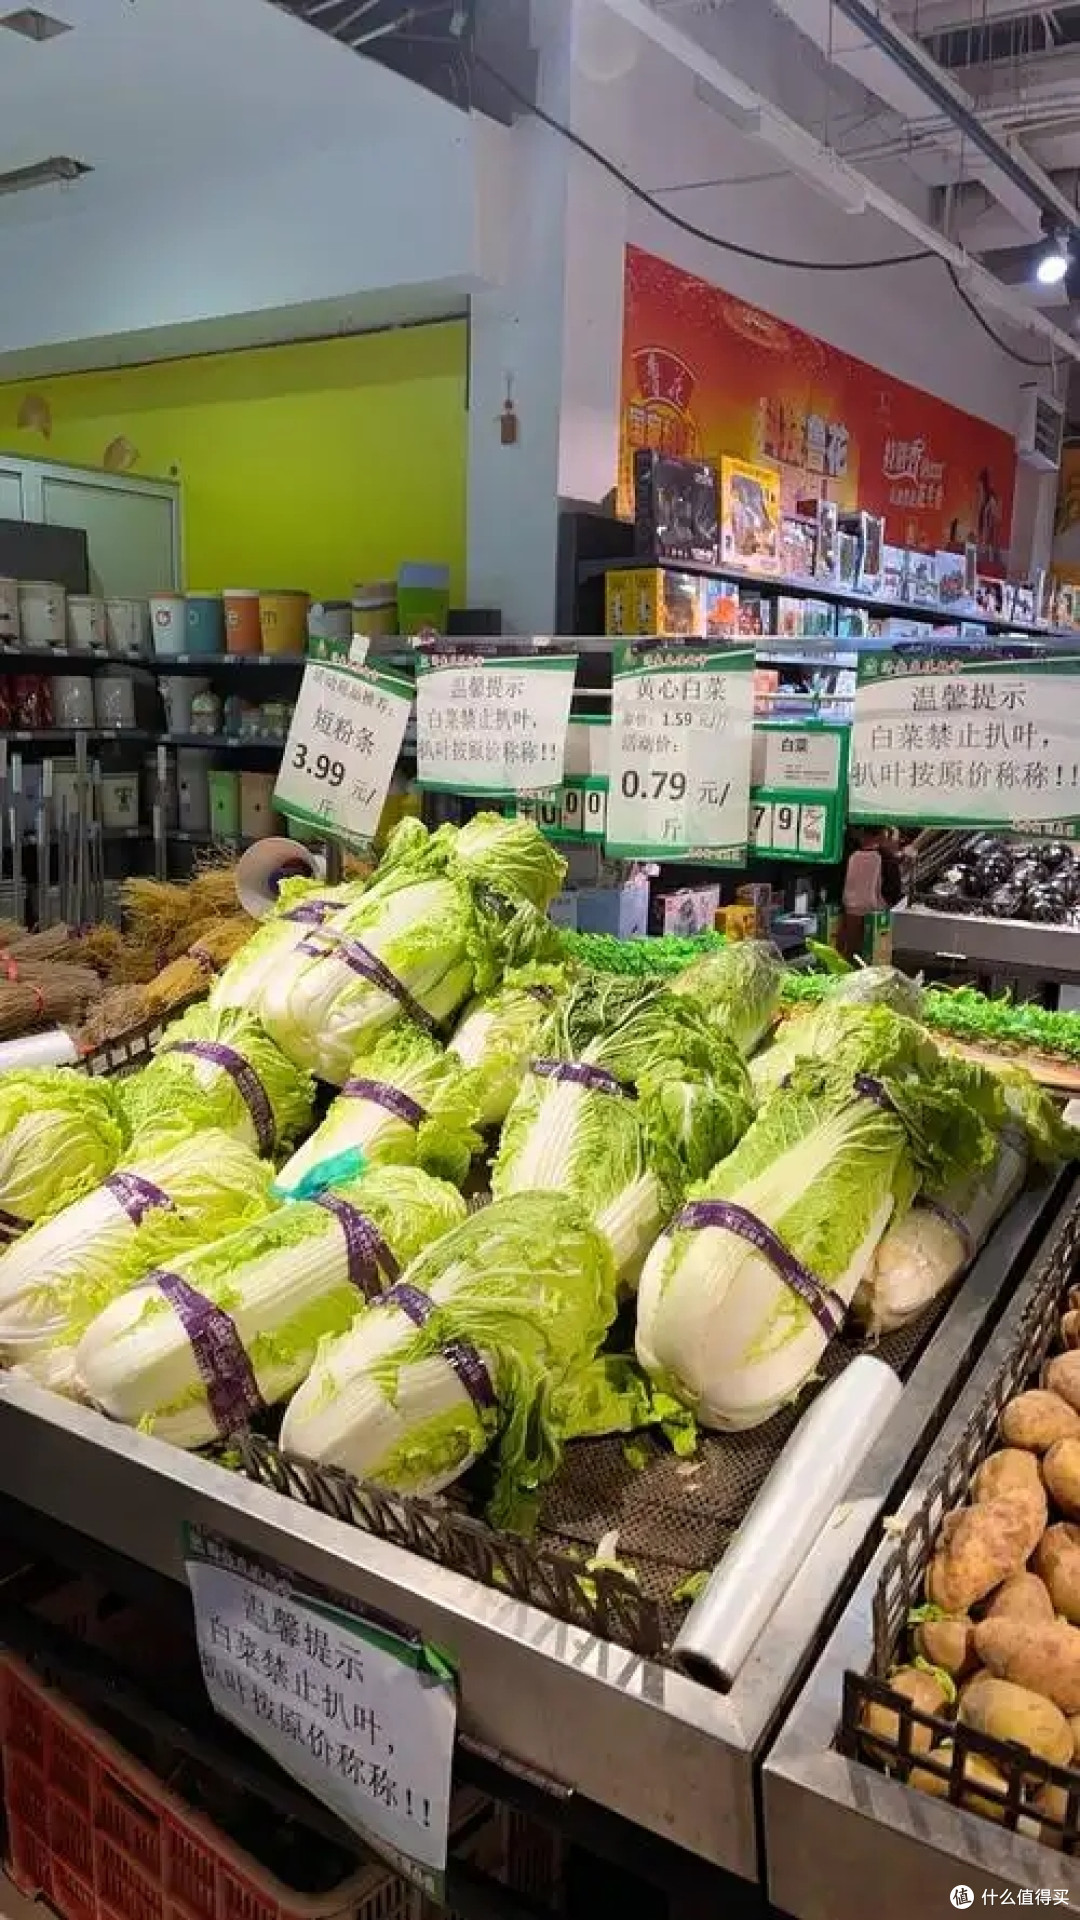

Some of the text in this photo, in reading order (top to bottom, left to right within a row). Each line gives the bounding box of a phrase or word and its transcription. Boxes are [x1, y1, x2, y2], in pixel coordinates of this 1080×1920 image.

[450, 675, 525, 699] 温馨提示
[637, 676, 727, 701] 黄心白菜
[912, 681, 1027, 712] 温馨提示
[313, 704, 376, 756] 短粉条
[663, 711, 693, 728] 1.59
[292, 743, 346, 787] 3.99
[621, 769, 688, 801] 0.79
[243, 1588, 364, 1684] 温馨提示
